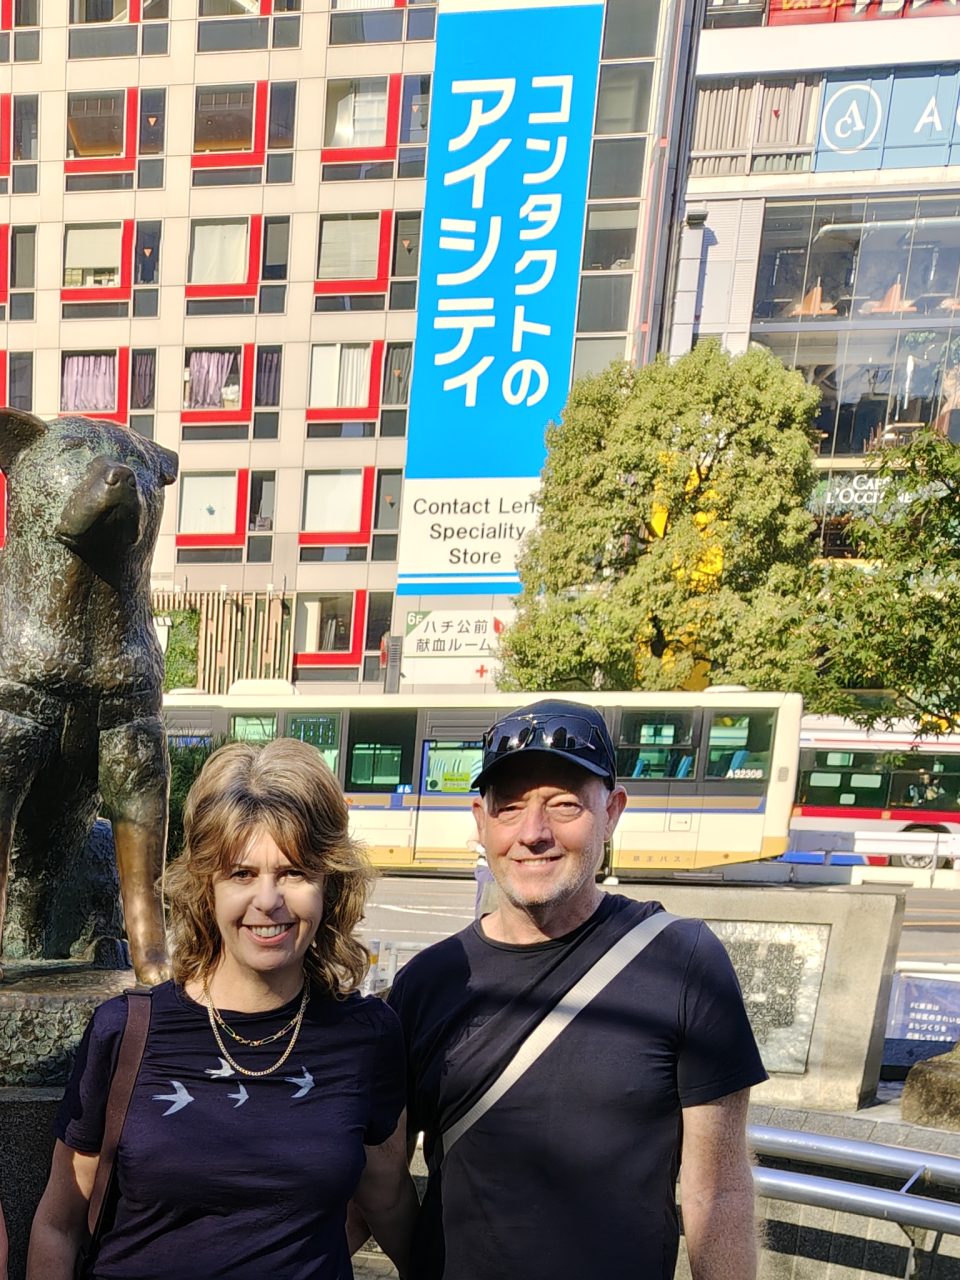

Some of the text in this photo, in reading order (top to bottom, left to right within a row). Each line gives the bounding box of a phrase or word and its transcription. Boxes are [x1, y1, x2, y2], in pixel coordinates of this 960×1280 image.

[433, 77, 517, 407] アイシティ
[502, 74, 574, 407] コンタクトの
[413, 497, 490, 515] Contact
[429, 522, 526, 541] Speciality
[448, 547, 502, 564] Store
[407, 612, 424, 625] 6F
[423, 619, 489, 634] ハチ公前
[416, 638, 492, 653] 献血ルーム
